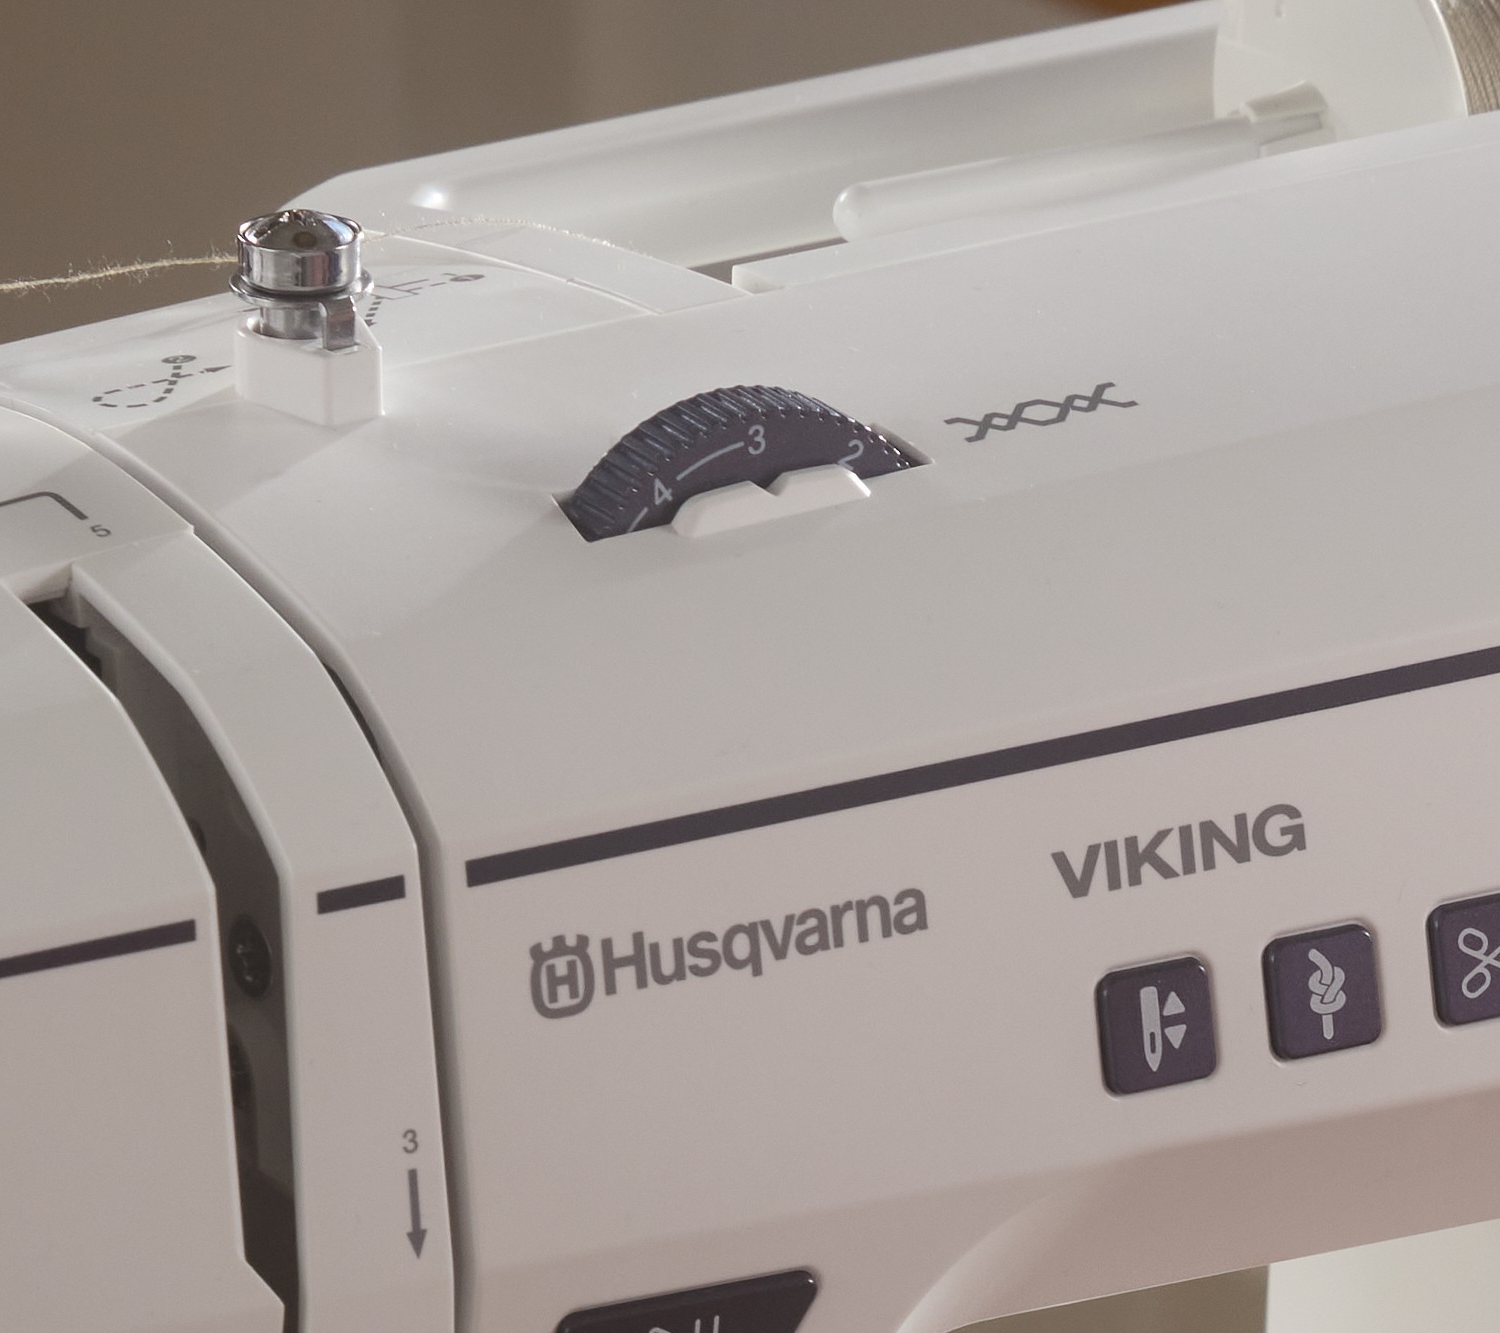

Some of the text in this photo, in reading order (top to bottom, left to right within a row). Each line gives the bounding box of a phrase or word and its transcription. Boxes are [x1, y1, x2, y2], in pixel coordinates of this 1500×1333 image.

[748, 425, 765, 455] 3
[837, 439, 864, 471] 2
[654, 478, 672, 505] 4
[90, 525, 111, 537] 5
[1051, 804, 1306, 898] VIKING
[601, 888, 928, 996] Husqvarna
[403, 1129, 419, 1154] 3
